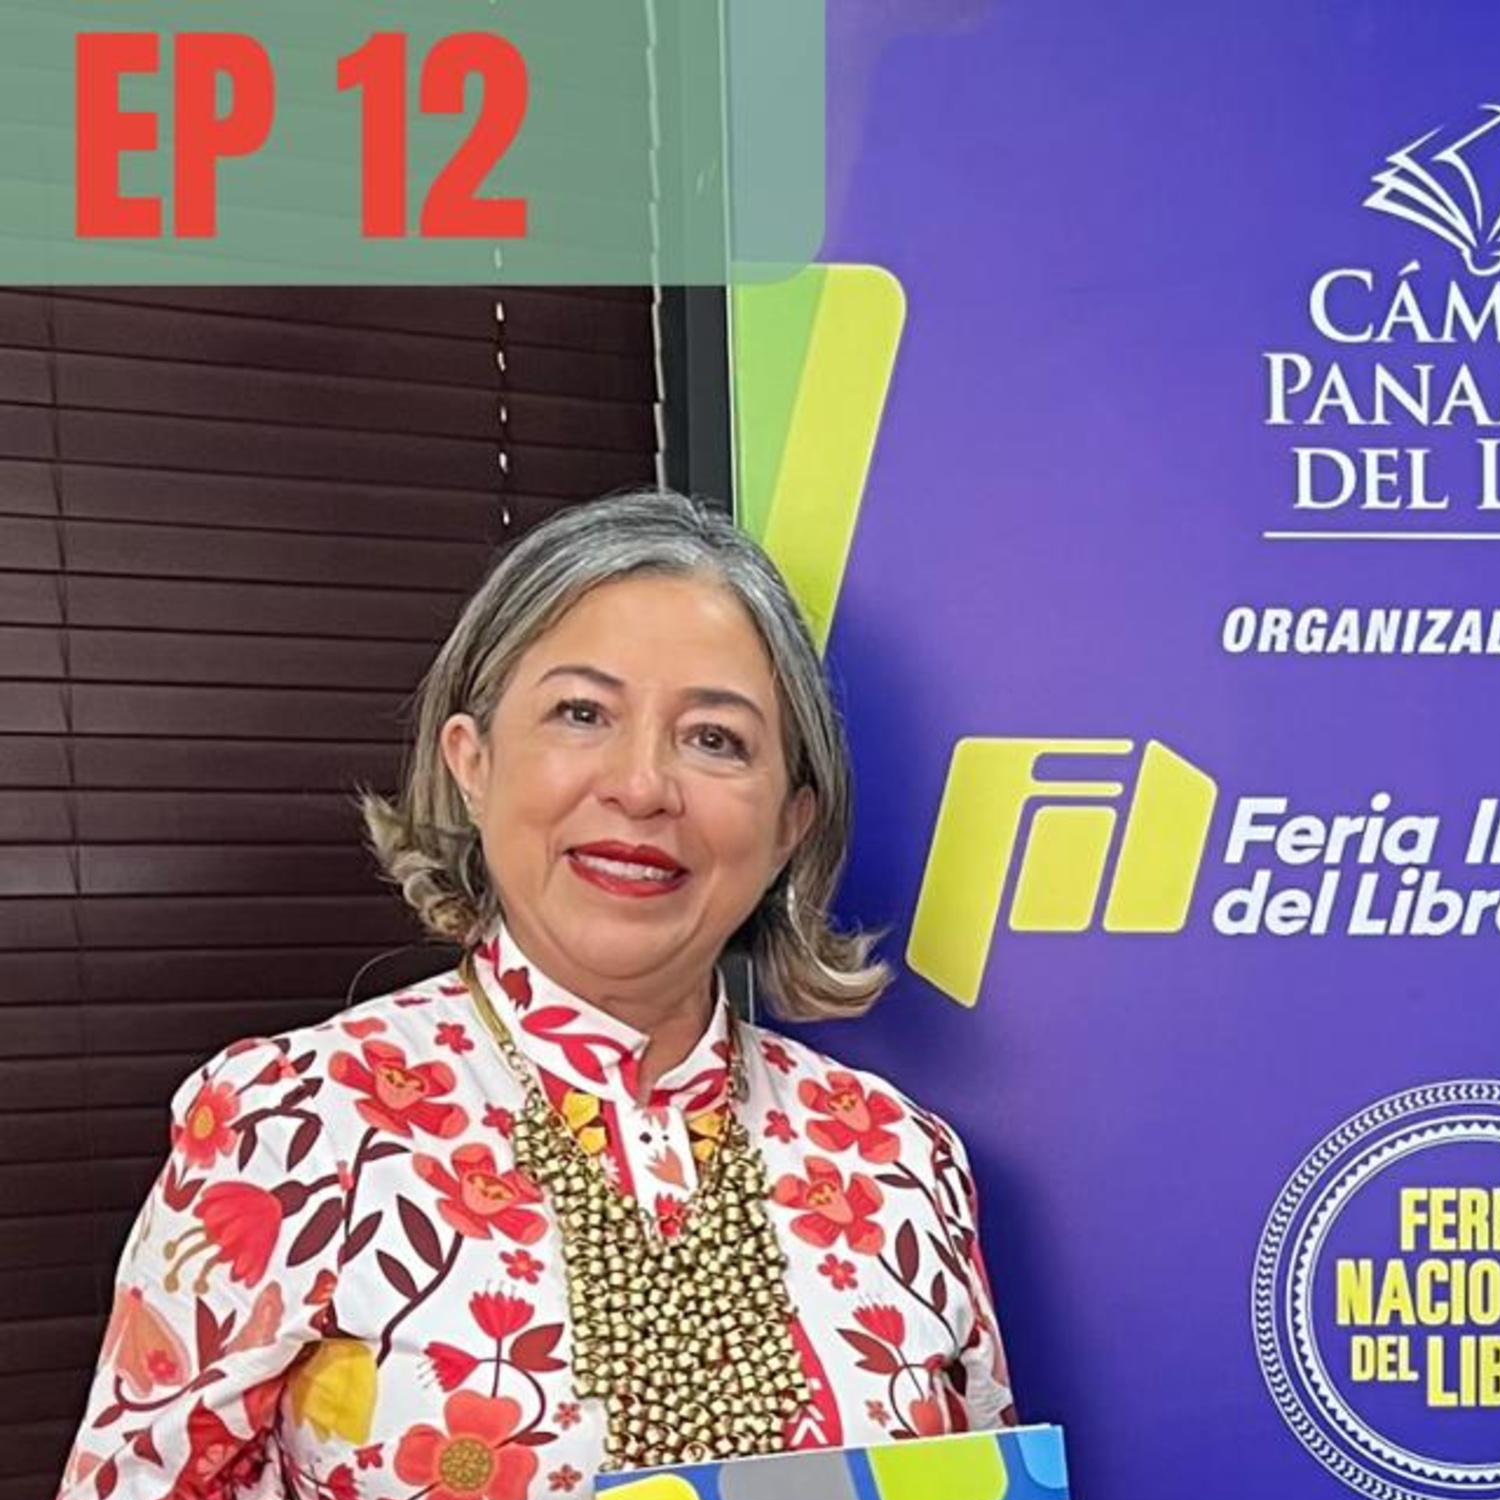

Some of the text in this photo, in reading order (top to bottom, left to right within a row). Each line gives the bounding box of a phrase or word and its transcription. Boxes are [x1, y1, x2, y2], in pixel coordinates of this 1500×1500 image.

[1293, 447, 1449, 510] DEL
[1225, 792, 1440, 865] Feria
[1212, 870, 1339, 936] del
[1350, 1335, 1419, 1381] DEL
